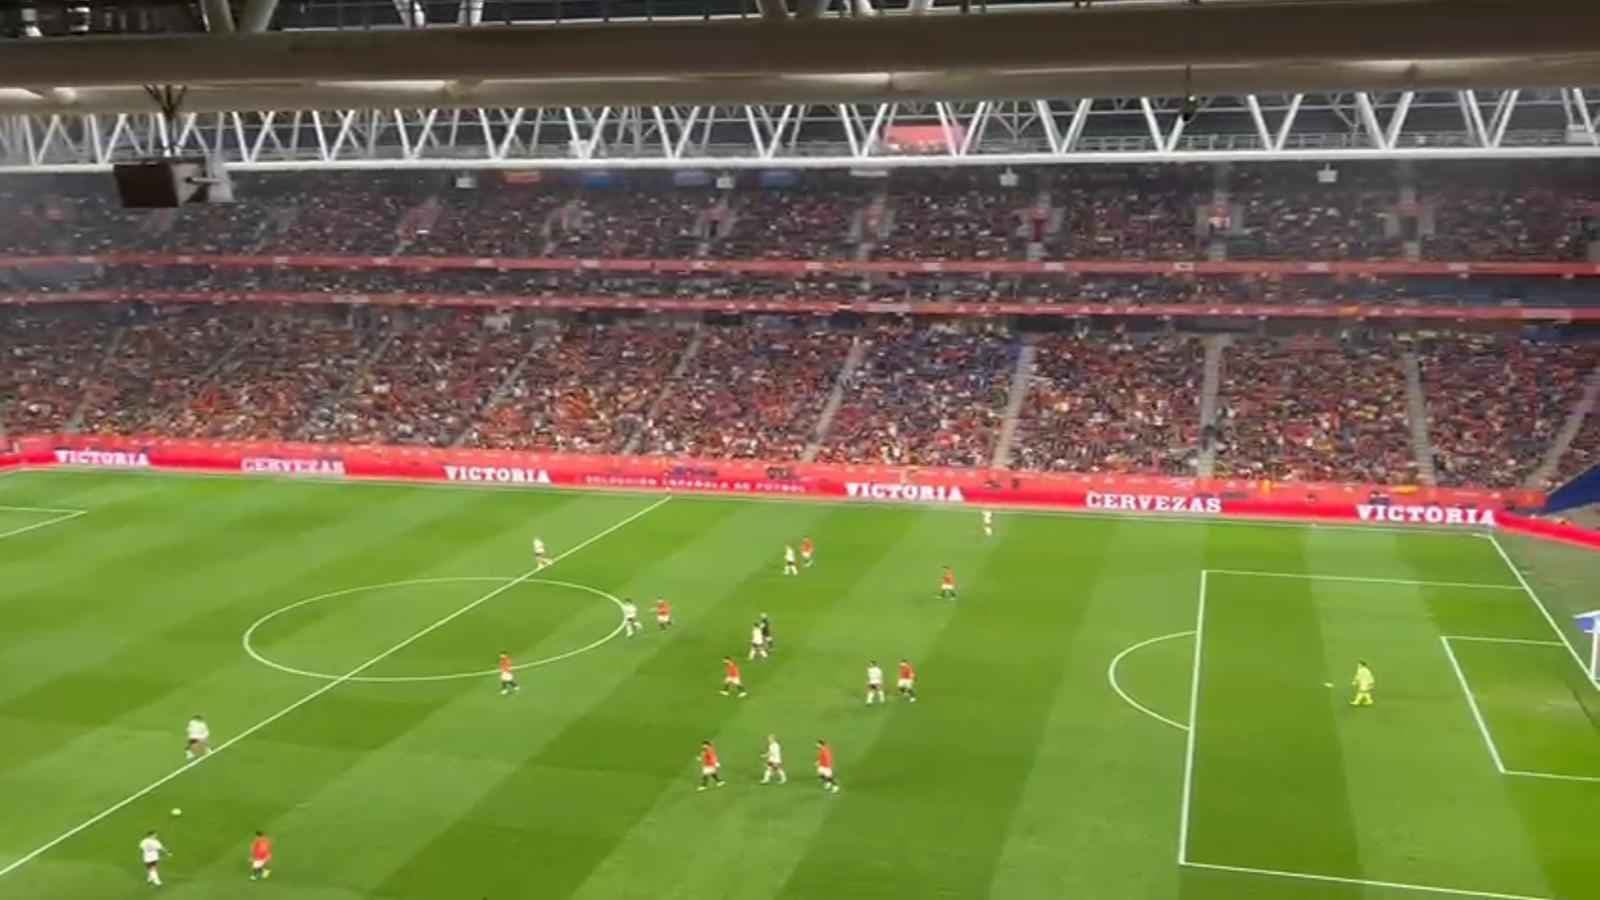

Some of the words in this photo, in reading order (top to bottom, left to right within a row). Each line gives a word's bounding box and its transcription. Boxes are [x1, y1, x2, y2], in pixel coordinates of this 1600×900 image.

[55, 450, 150, 466] VICTORIA
[241, 458, 345, 474] CERVEZAS
[444, 466, 551, 483] VICTORIA
[846, 482, 964, 502] VICTORIA
[1086, 492, 1222, 512] CERVEZAS
[1356, 504, 1497, 526] VICTORIA
